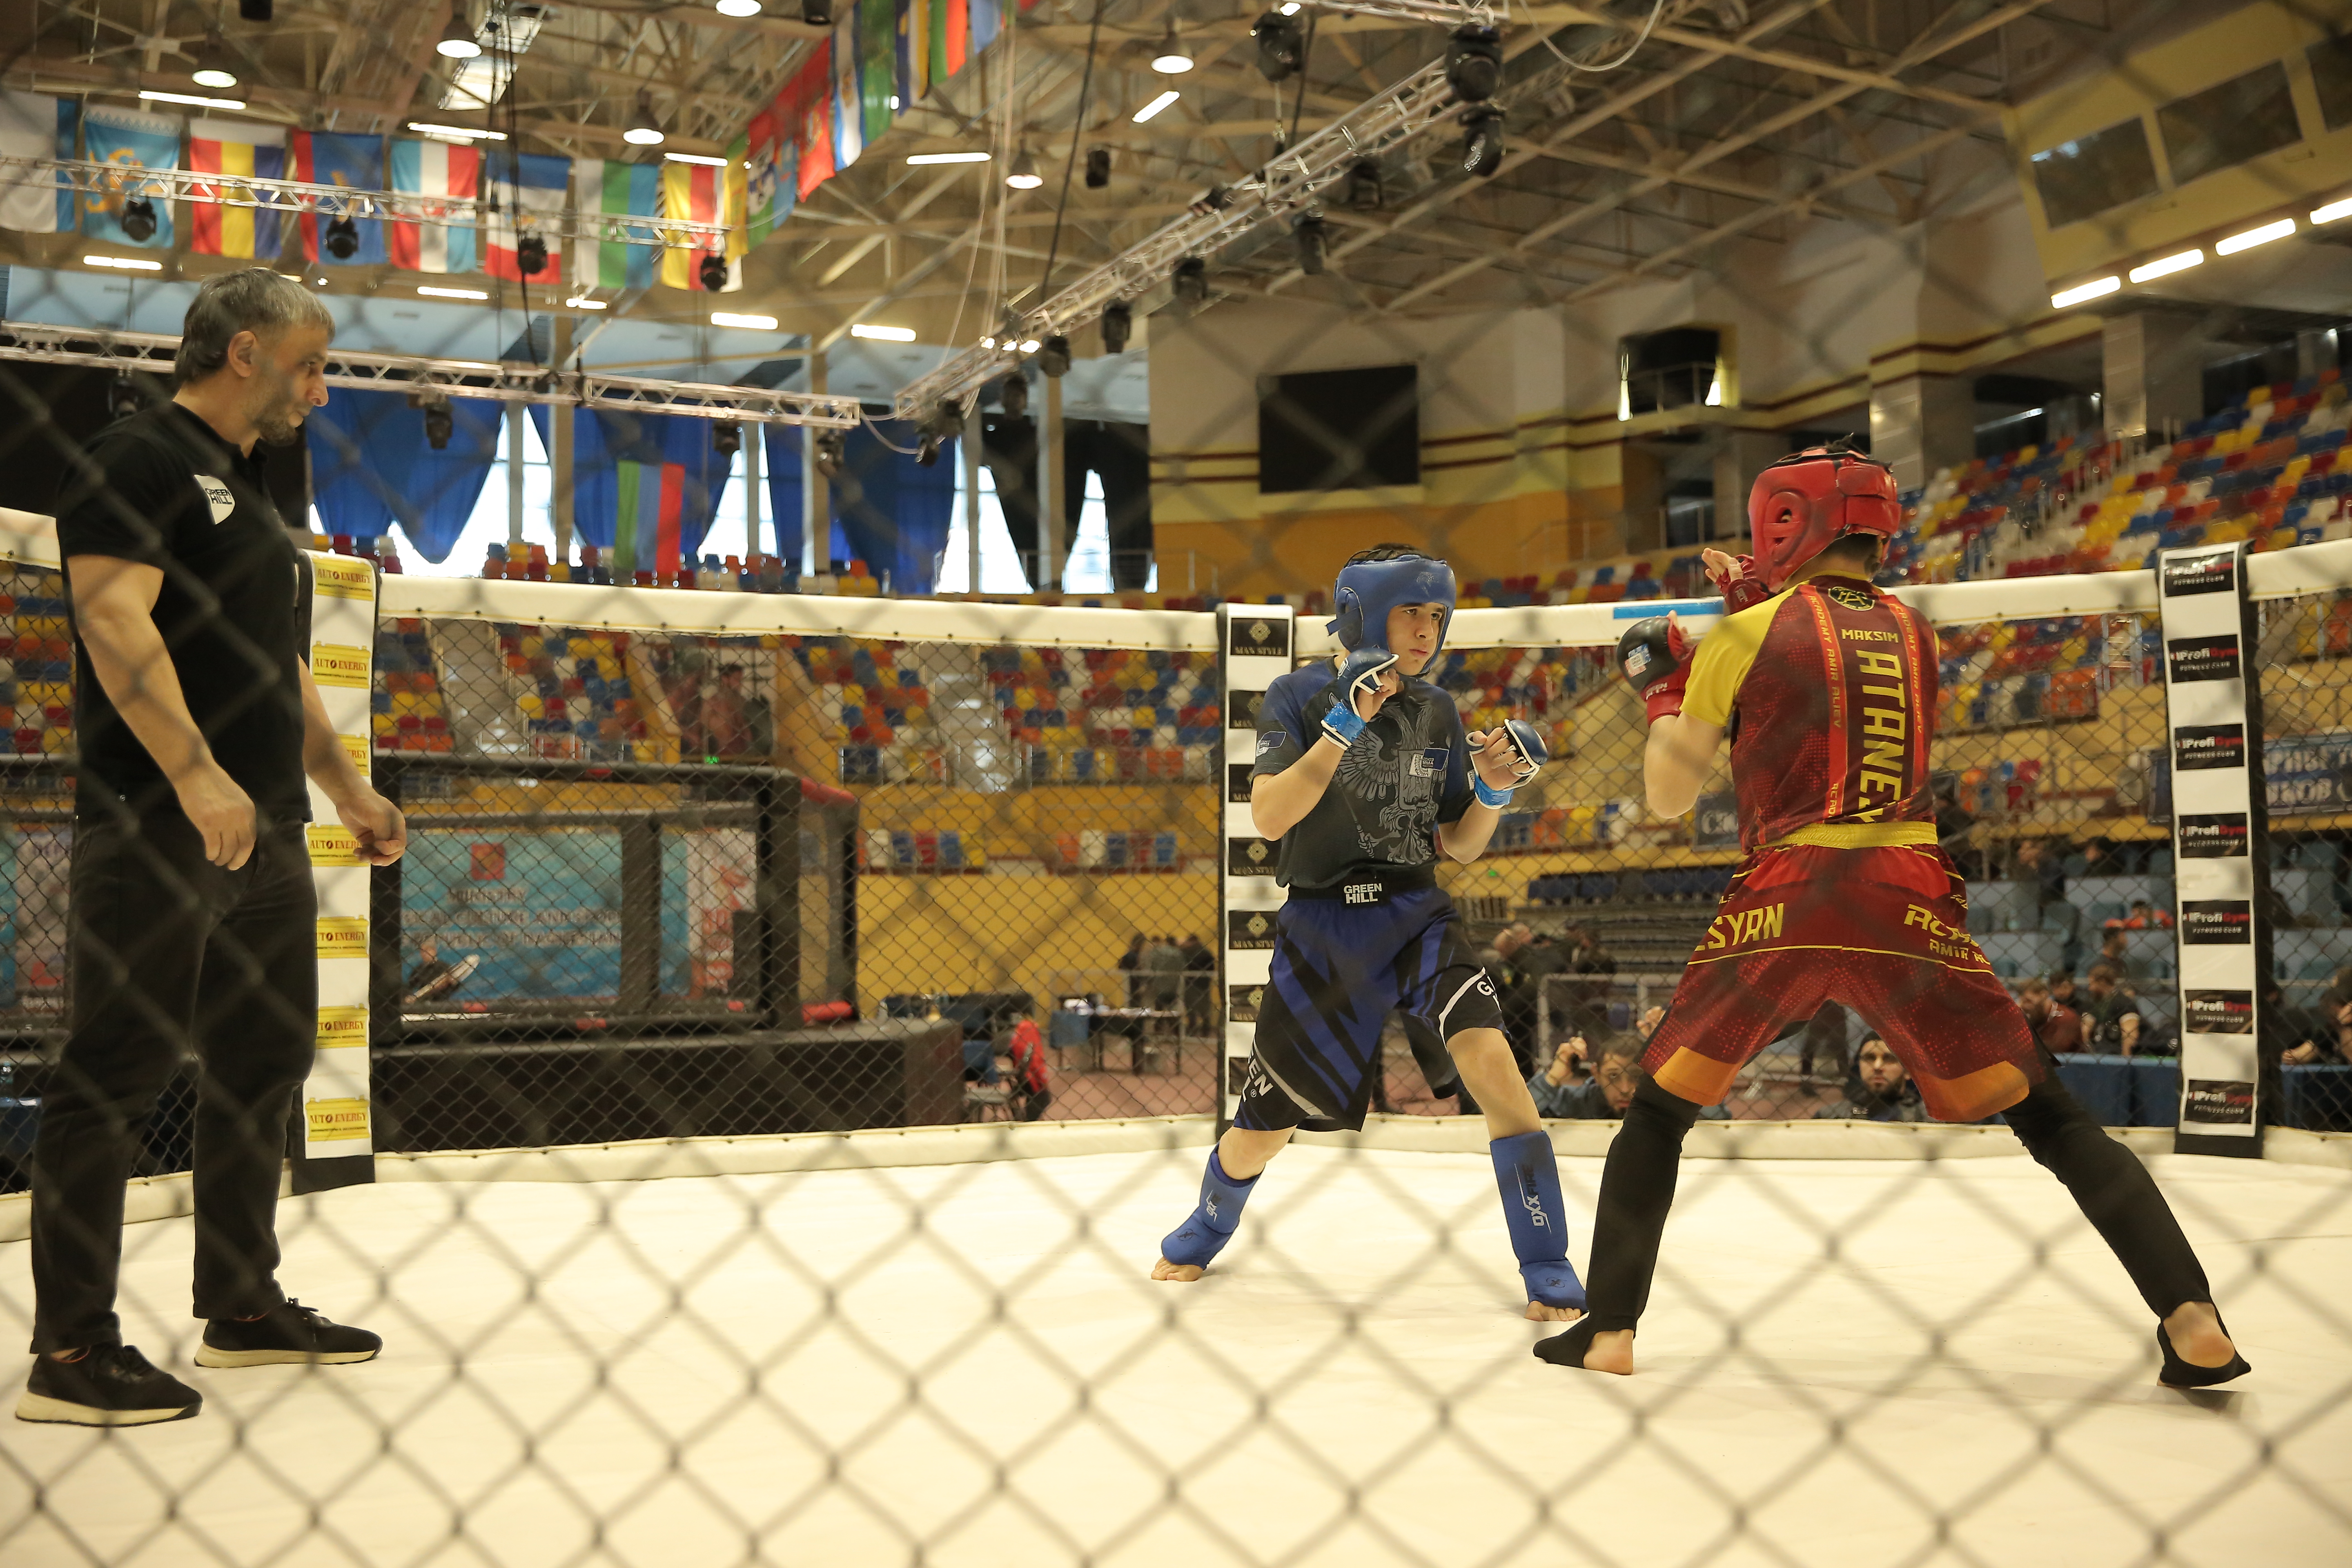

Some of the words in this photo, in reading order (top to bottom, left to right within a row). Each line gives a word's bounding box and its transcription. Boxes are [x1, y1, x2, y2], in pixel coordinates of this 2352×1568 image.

[204, 488, 232, 497] GREEN
[210, 495, 233, 505] HILL
[1841, 628, 1899, 644] MAKSIM
[1826, 648, 1839, 682] AMIR
[1832, 686, 1842, 728] ALIEV
[311, 840, 333, 849] AUTO
[1343, 883, 1383, 894] GREEN
[1345, 892, 1379, 904] HILL
[1255, 940, 1274, 949] STYL
[334, 1020, 363, 1031] ENERGY
[335, 1112, 366, 1123] ENERGY
